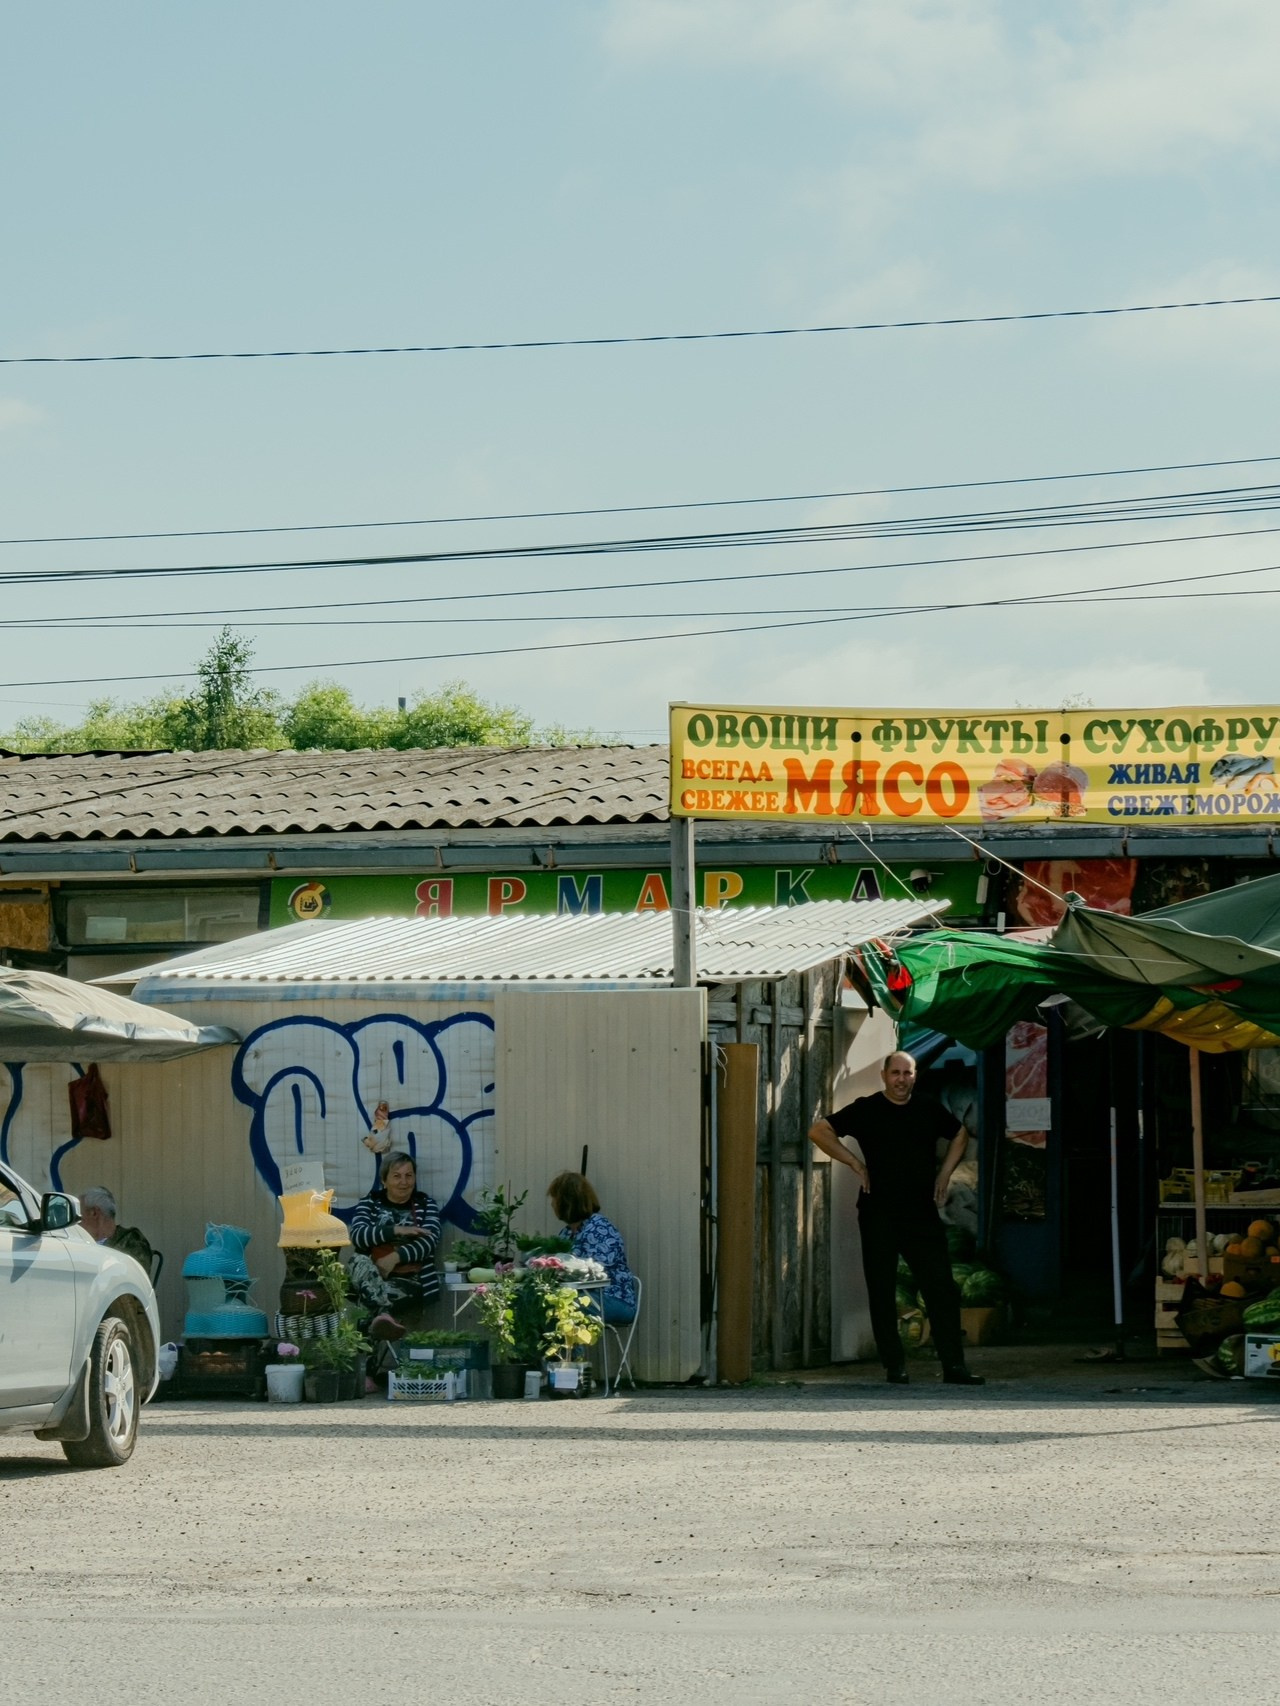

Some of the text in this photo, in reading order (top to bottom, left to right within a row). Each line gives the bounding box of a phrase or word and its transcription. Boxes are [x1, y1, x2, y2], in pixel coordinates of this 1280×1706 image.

[687, 713, 839, 755] ОВОЩИ
[871, 718, 1049, 755] ФРУКТЫ
[681, 759, 773, 784] ВСЕГДА
[783, 757, 971, 818] МЯСО
[1107, 762, 1201, 785] ЖИВАЯ
[680, 788, 780, 813] СВЕЖЕЕ
[415, 867, 883, 917] ЯРМАРКА
